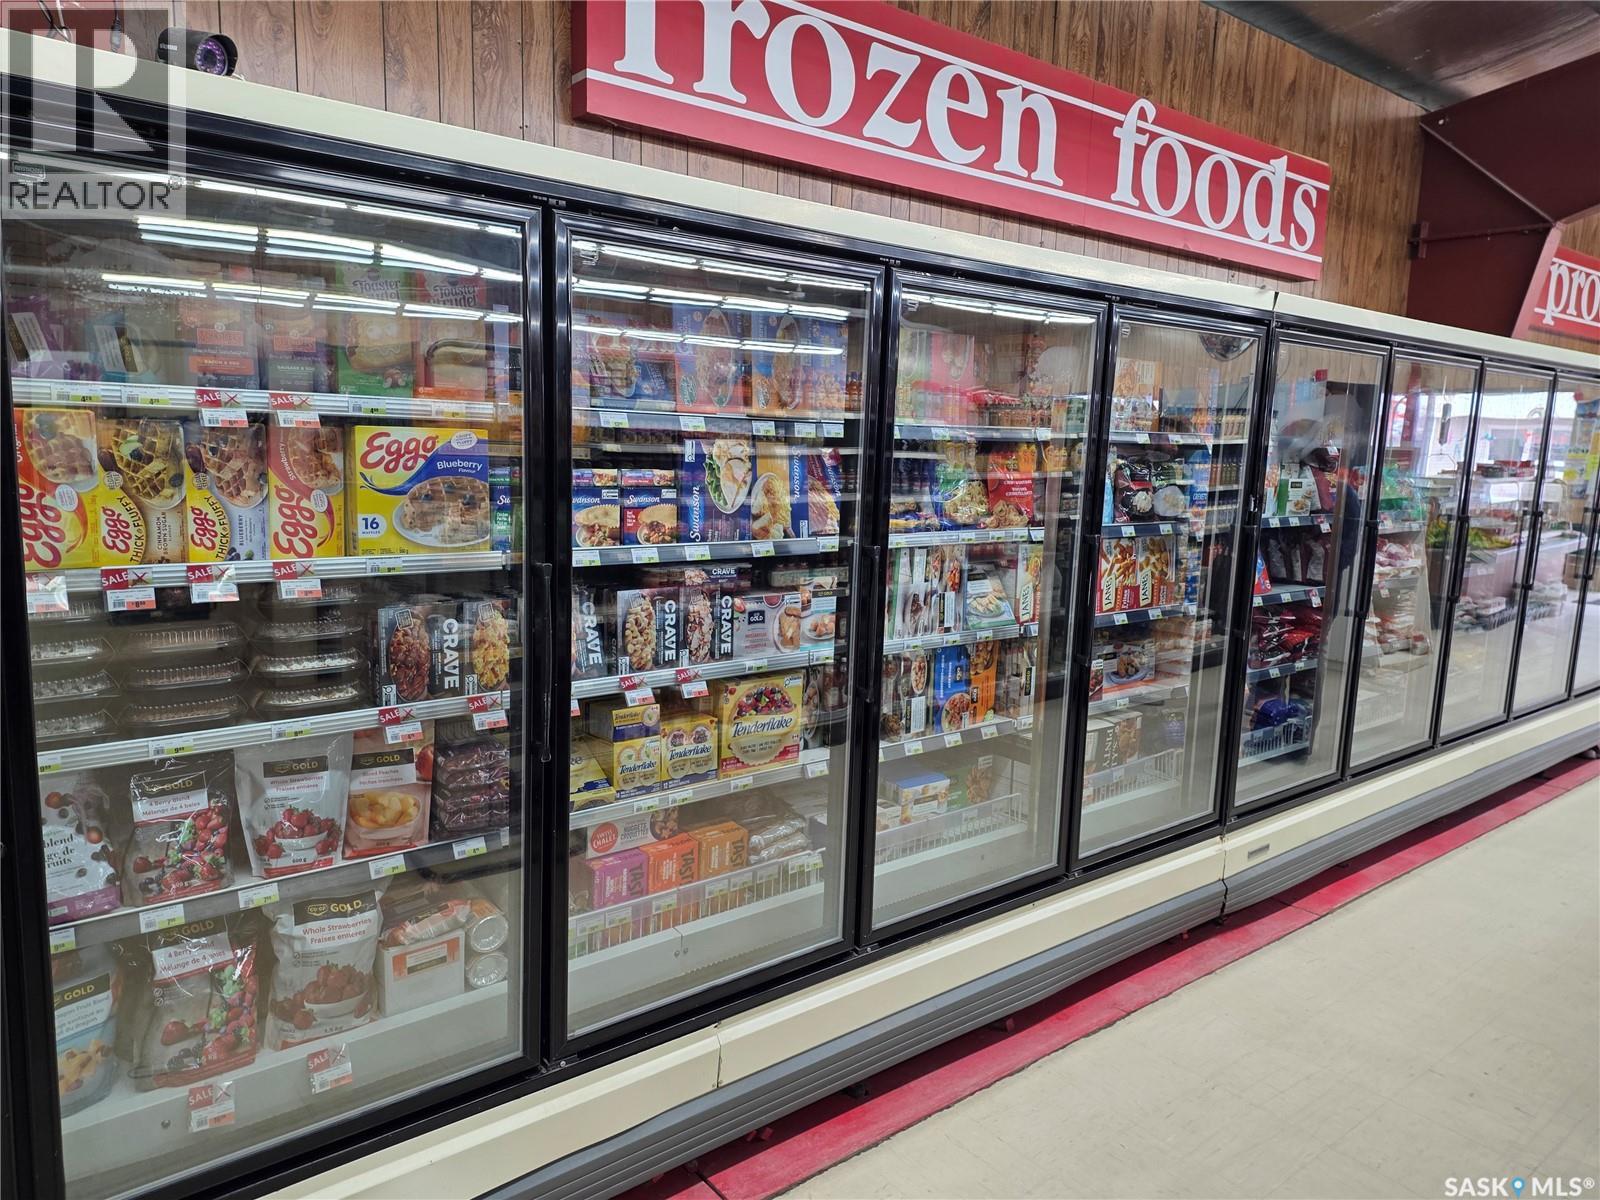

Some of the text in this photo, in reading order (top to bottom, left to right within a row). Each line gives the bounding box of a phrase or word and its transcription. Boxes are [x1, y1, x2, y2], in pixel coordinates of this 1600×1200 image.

[1110, 98, 1318, 252] foods
[353, 279, 400, 292] Toaster
[434, 285, 478, 299] Toaster
[196, 391, 222, 403] SALE
[271, 394, 295, 406] SALE
[359, 431, 439, 474] Eggo
[279, 441, 297, 482] Strawberry
[436, 459, 483, 472] Blueberry
[792, 446, 801, 499] Swanson
[627, 494, 660, 505] Swanson
[117, 495, 144, 530] FLUFFY
[204, 495, 229, 528] FLUFFY
[689, 486, 701, 543] Swanson
[19, 483, 66, 569] Eggo
[190, 505, 219, 551] Eggo
[273, 484, 318, 559] Eggo
[362, 517, 380, 530] 16
[102, 507, 133, 554] Eggo
[130, 535, 145, 563] THICK
[216, 532, 229, 560] THICK
[187, 566, 213, 580] SALE
[273, 563, 298, 577] SALE
[102, 571, 129, 587] SALE
[1105, 577, 1113, 607] JANES
[1141, 573, 1149, 602] JANES
[1022, 586, 1032, 617] JANES
[582, 601, 603, 665] CRAVE
[664, 599, 676, 662] CRAVE
[720, 595, 733, 655] CRAVE
[442, 618, 460, 690] CRAVE
[621, 677, 636, 690] SALE
[677, 669, 691, 682] SALE
[469, 698, 488, 711] SALE
[379, 709, 400, 723] SALE
[732, 715, 793, 738] Tenderflake
[376, 754, 401, 764] GOLD
[668, 744, 712, 762] Tenderflake
[291, 760, 319, 771] GOLD
[378, 768, 399, 776] Peaches
[619, 759, 657, 775] Tenderflake
[289, 774, 324, 784] Strawberries
[154, 797, 170, 806] Berry
[184, 801, 201, 810] baies
[592, 835, 618, 848] CHALET
[62, 847, 75, 857] de
[46, 857, 73, 869] ruits
[330, 898, 363, 912] GOLD
[180, 919, 215, 936] GOLD
[302, 916, 372, 936] Whole Strawberries
[310, 935, 336, 945] Fraises
[173, 948, 193, 959] Berry
[192, 956, 201, 964] de
[63, 984, 95, 1002] GOLD
[76, 1001, 91, 1012] Fruit
[74, 1016, 98, 1031] dragon
[307, 1053, 329, 1070] SALE
[188, 1088, 214, 1106] SALE
